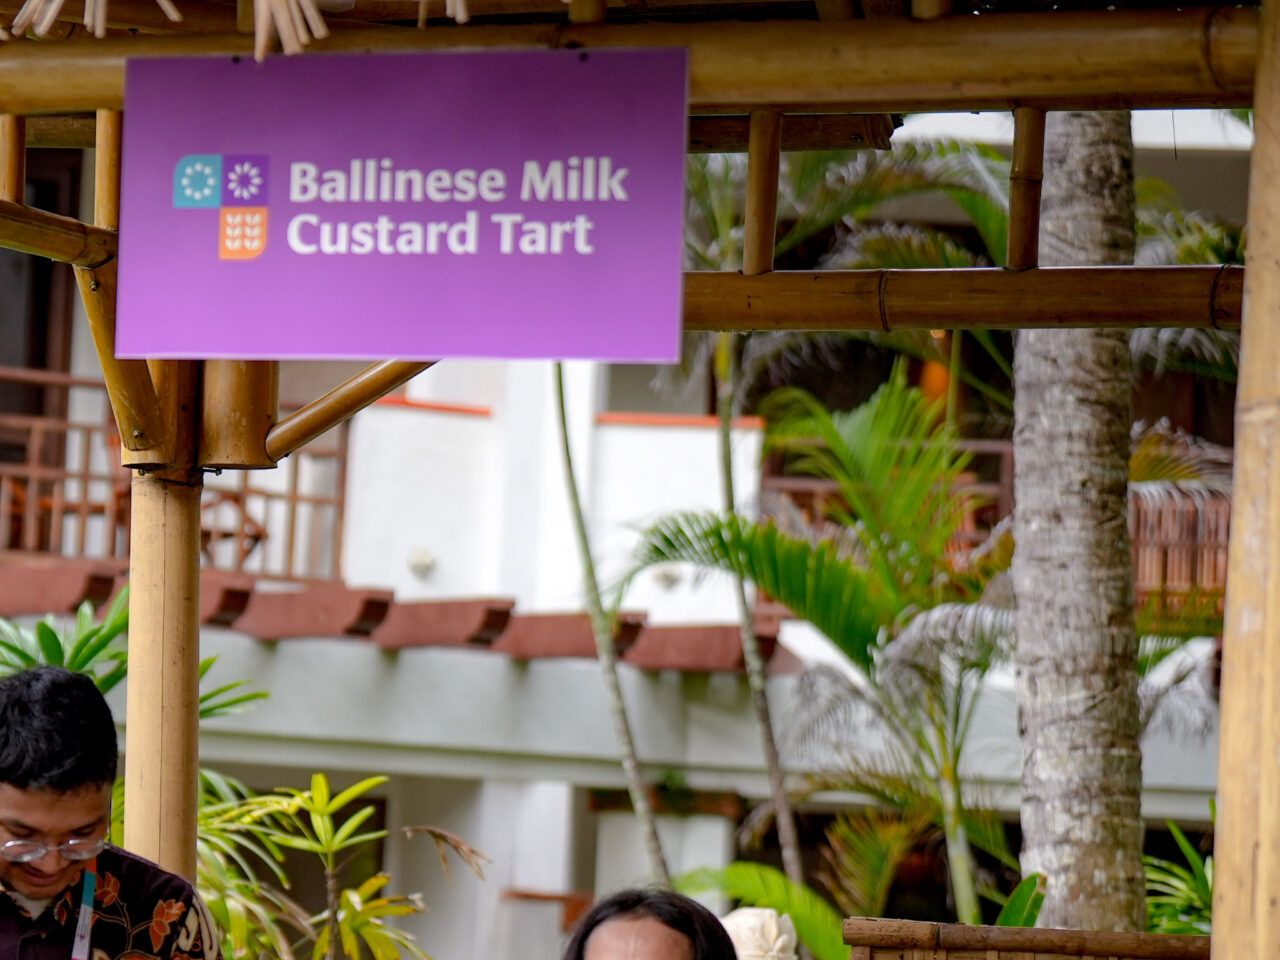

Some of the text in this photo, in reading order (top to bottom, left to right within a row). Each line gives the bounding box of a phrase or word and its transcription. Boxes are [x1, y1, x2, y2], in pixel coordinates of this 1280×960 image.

[288, 155, 630, 203] Ballinese Milk
[286, 209, 596, 255] Custard Tart
